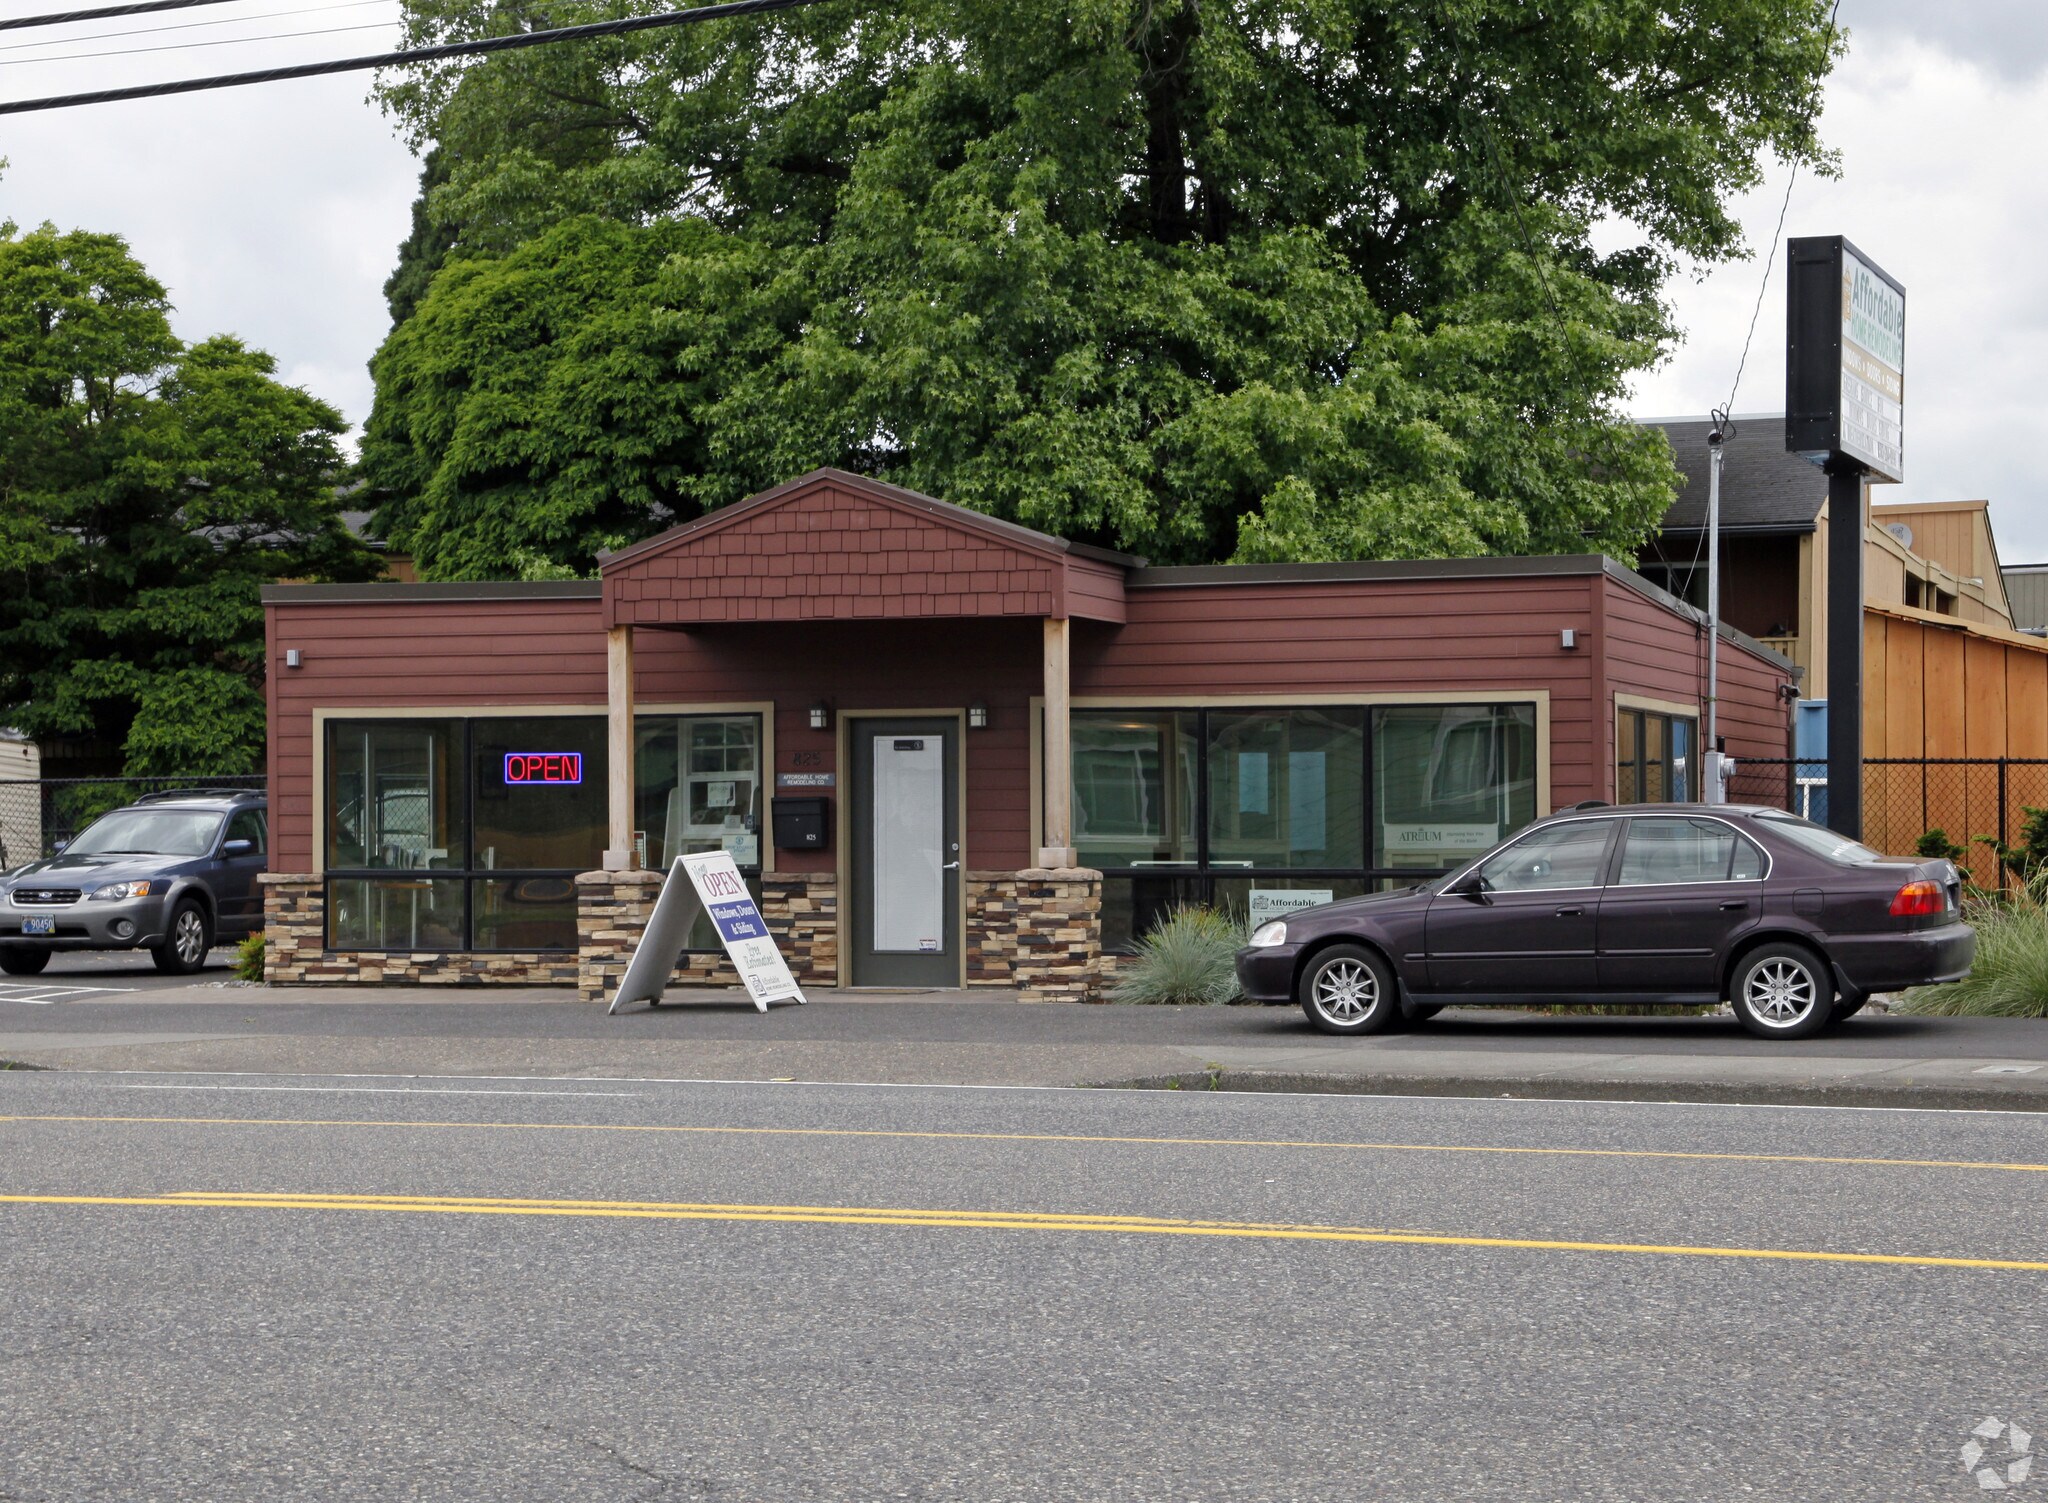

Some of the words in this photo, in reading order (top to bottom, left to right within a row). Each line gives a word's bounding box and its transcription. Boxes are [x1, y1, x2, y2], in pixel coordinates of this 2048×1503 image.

[1852, 267, 1902, 339] Affordable
[793, 752, 822, 766] 825
[508, 755, 578, 781] OPEN
[1398, 831, 1442, 842] ATRIUM
[702, 870, 743, 897] OPEN
[1270, 899, 1316, 907] Affordable
[712, 907, 741, 919] Windows,
[736, 905, 755, 916] Doors
[730, 923, 738, 935] &
[735, 922, 757, 935] Siding
